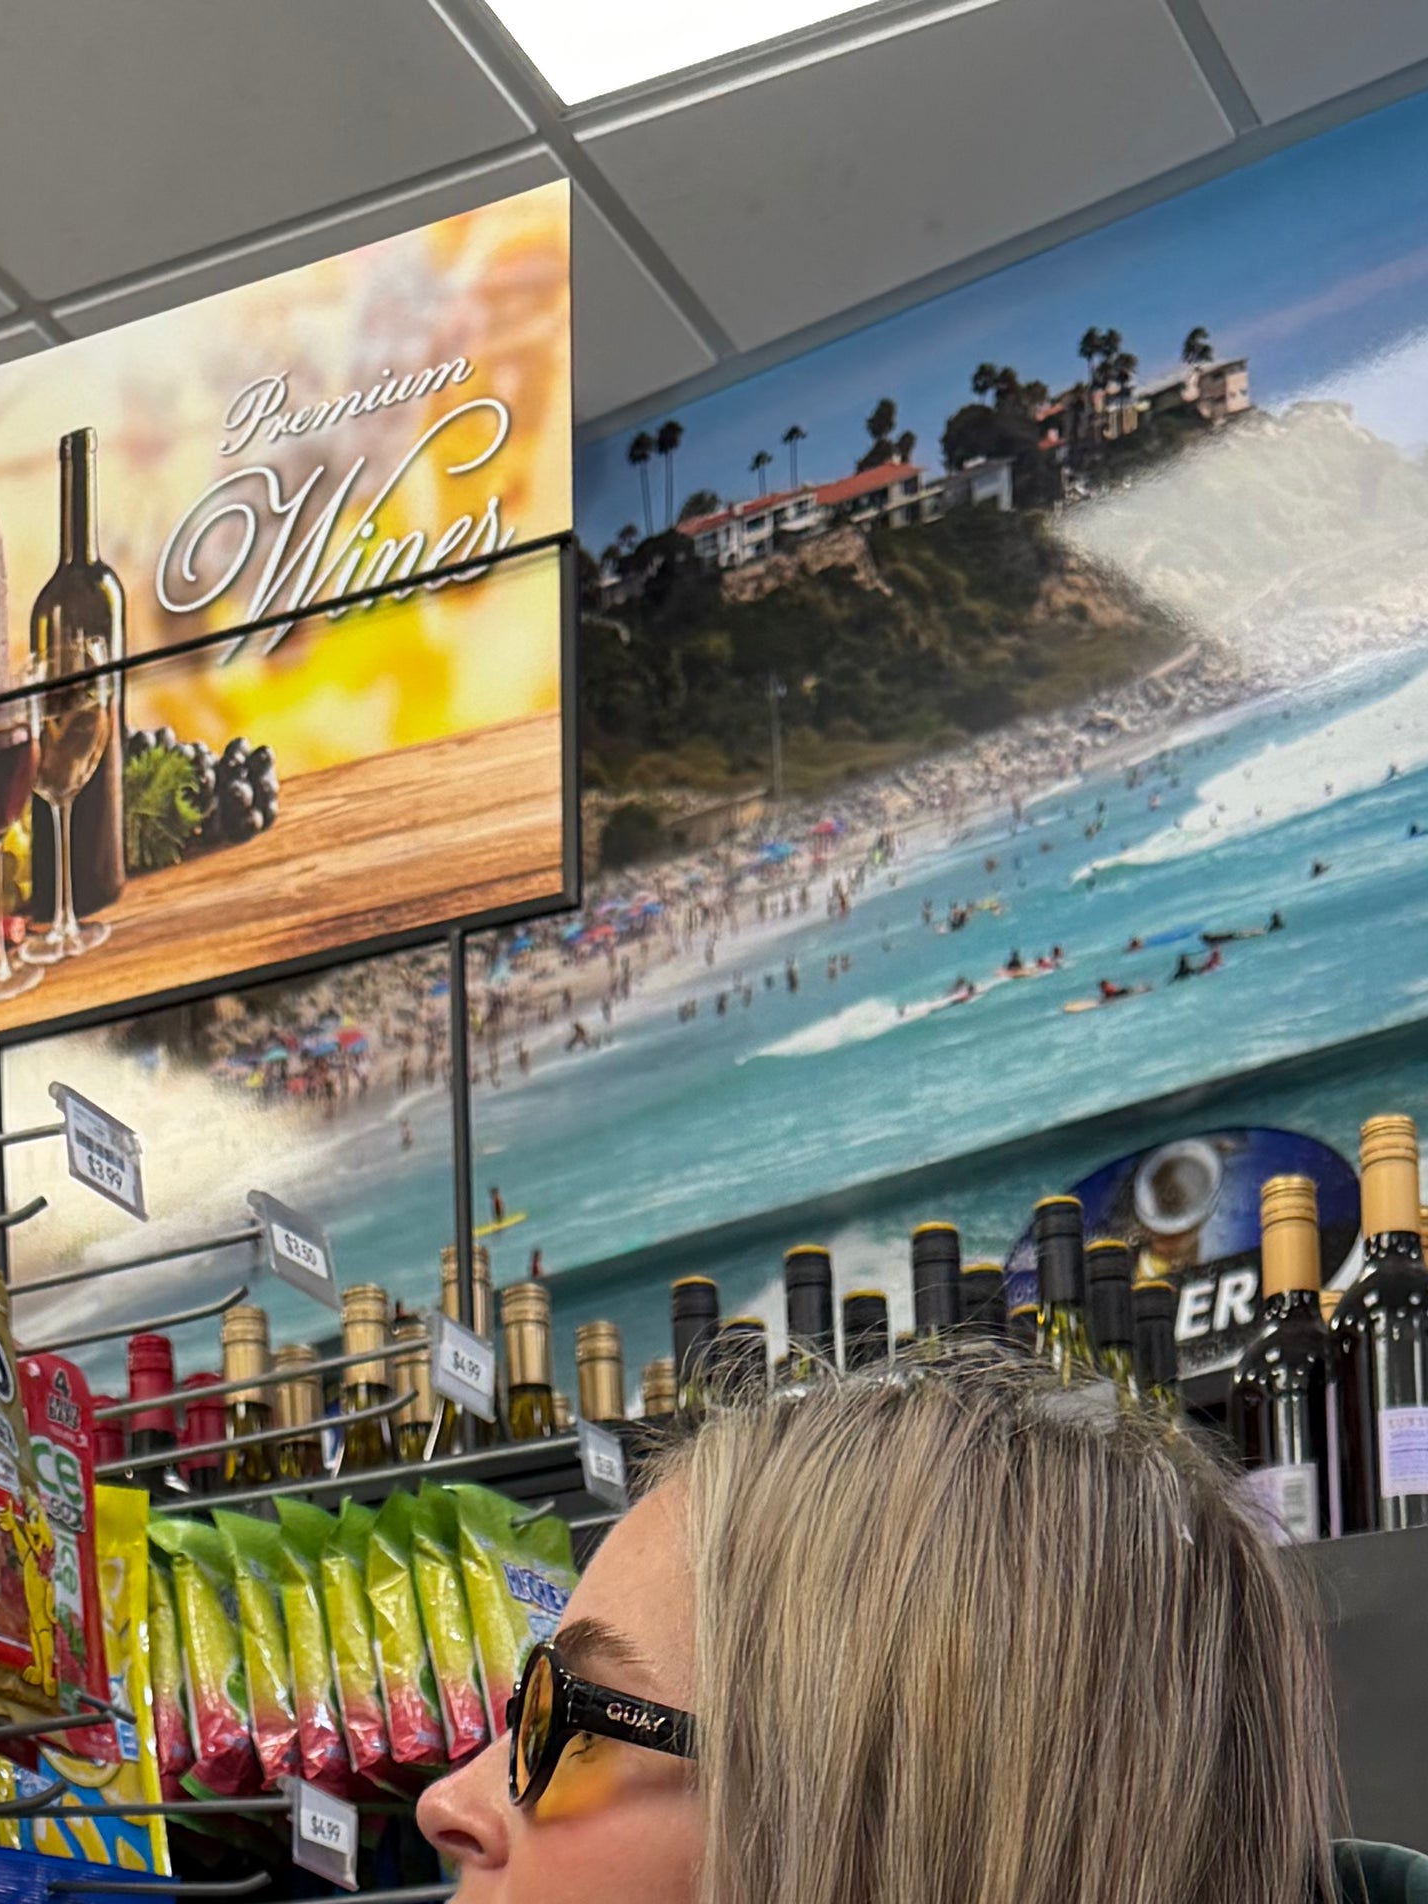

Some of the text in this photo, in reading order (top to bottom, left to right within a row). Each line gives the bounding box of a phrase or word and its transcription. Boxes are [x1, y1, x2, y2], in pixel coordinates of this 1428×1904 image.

[222, 356, 473, 455] Premium
[155, 397, 515, 666] Wines
[606, 1702, 667, 1732] QUAY
